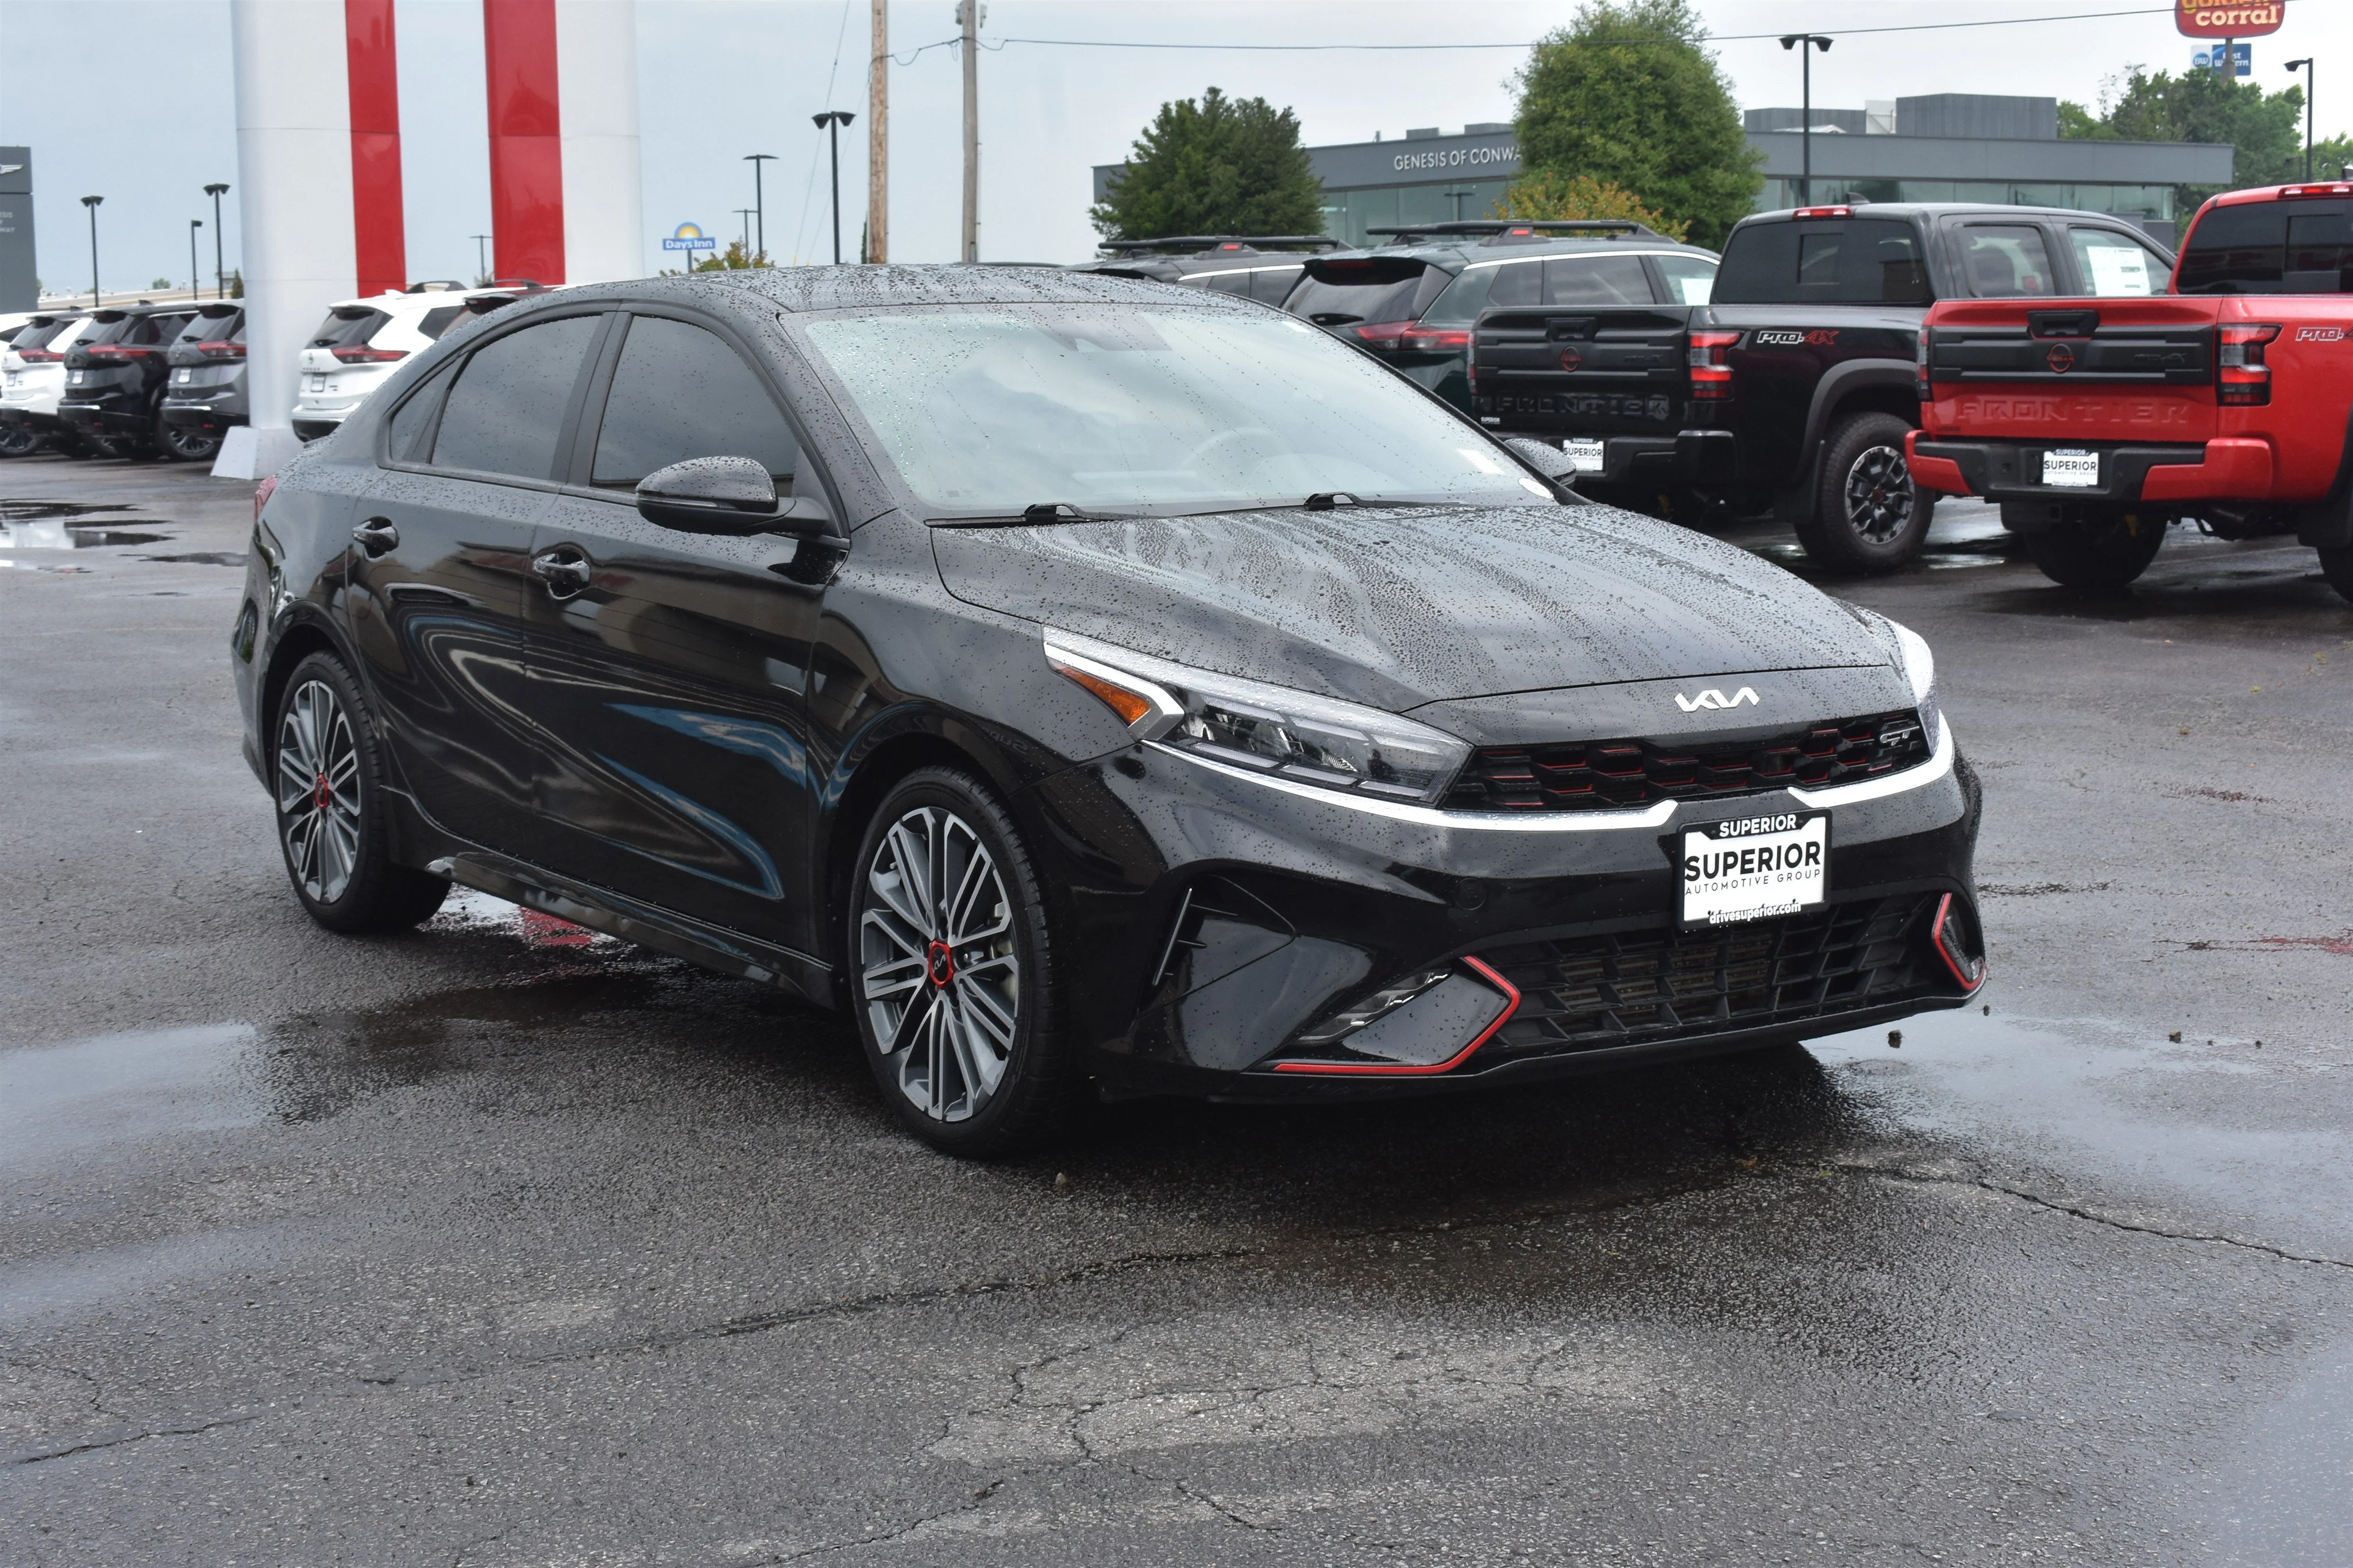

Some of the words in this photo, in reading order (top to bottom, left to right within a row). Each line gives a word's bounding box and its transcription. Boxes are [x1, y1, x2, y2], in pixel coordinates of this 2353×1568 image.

[2196, 5, 2278, 26] corral
[1394, 151, 1447, 171] GENESIS
[1449, 150, 1467, 166] OF
[1469, 145, 1523, 164] CONWA
[665, 240, 693, 249] Days
[694, 239, 713, 248] Inn
[1496, 396, 1669, 417] FRONTIER
[1956, 401, 2190, 424] FRONTIER
[1563, 447, 1603, 458] SUPERIOR
[2044, 460, 2097, 471] SUPERIOR
[1880, 725, 1920, 747] GT
[1719, 814, 1797, 837] SUPERIOR
[1685, 841, 1820, 882] SUPERIOR
[1684, 875, 1769, 896] AUTOMOTIVE
[1777, 868, 1820, 883] GROUP
[1709, 902, 1802, 924] drivesuperior.com
